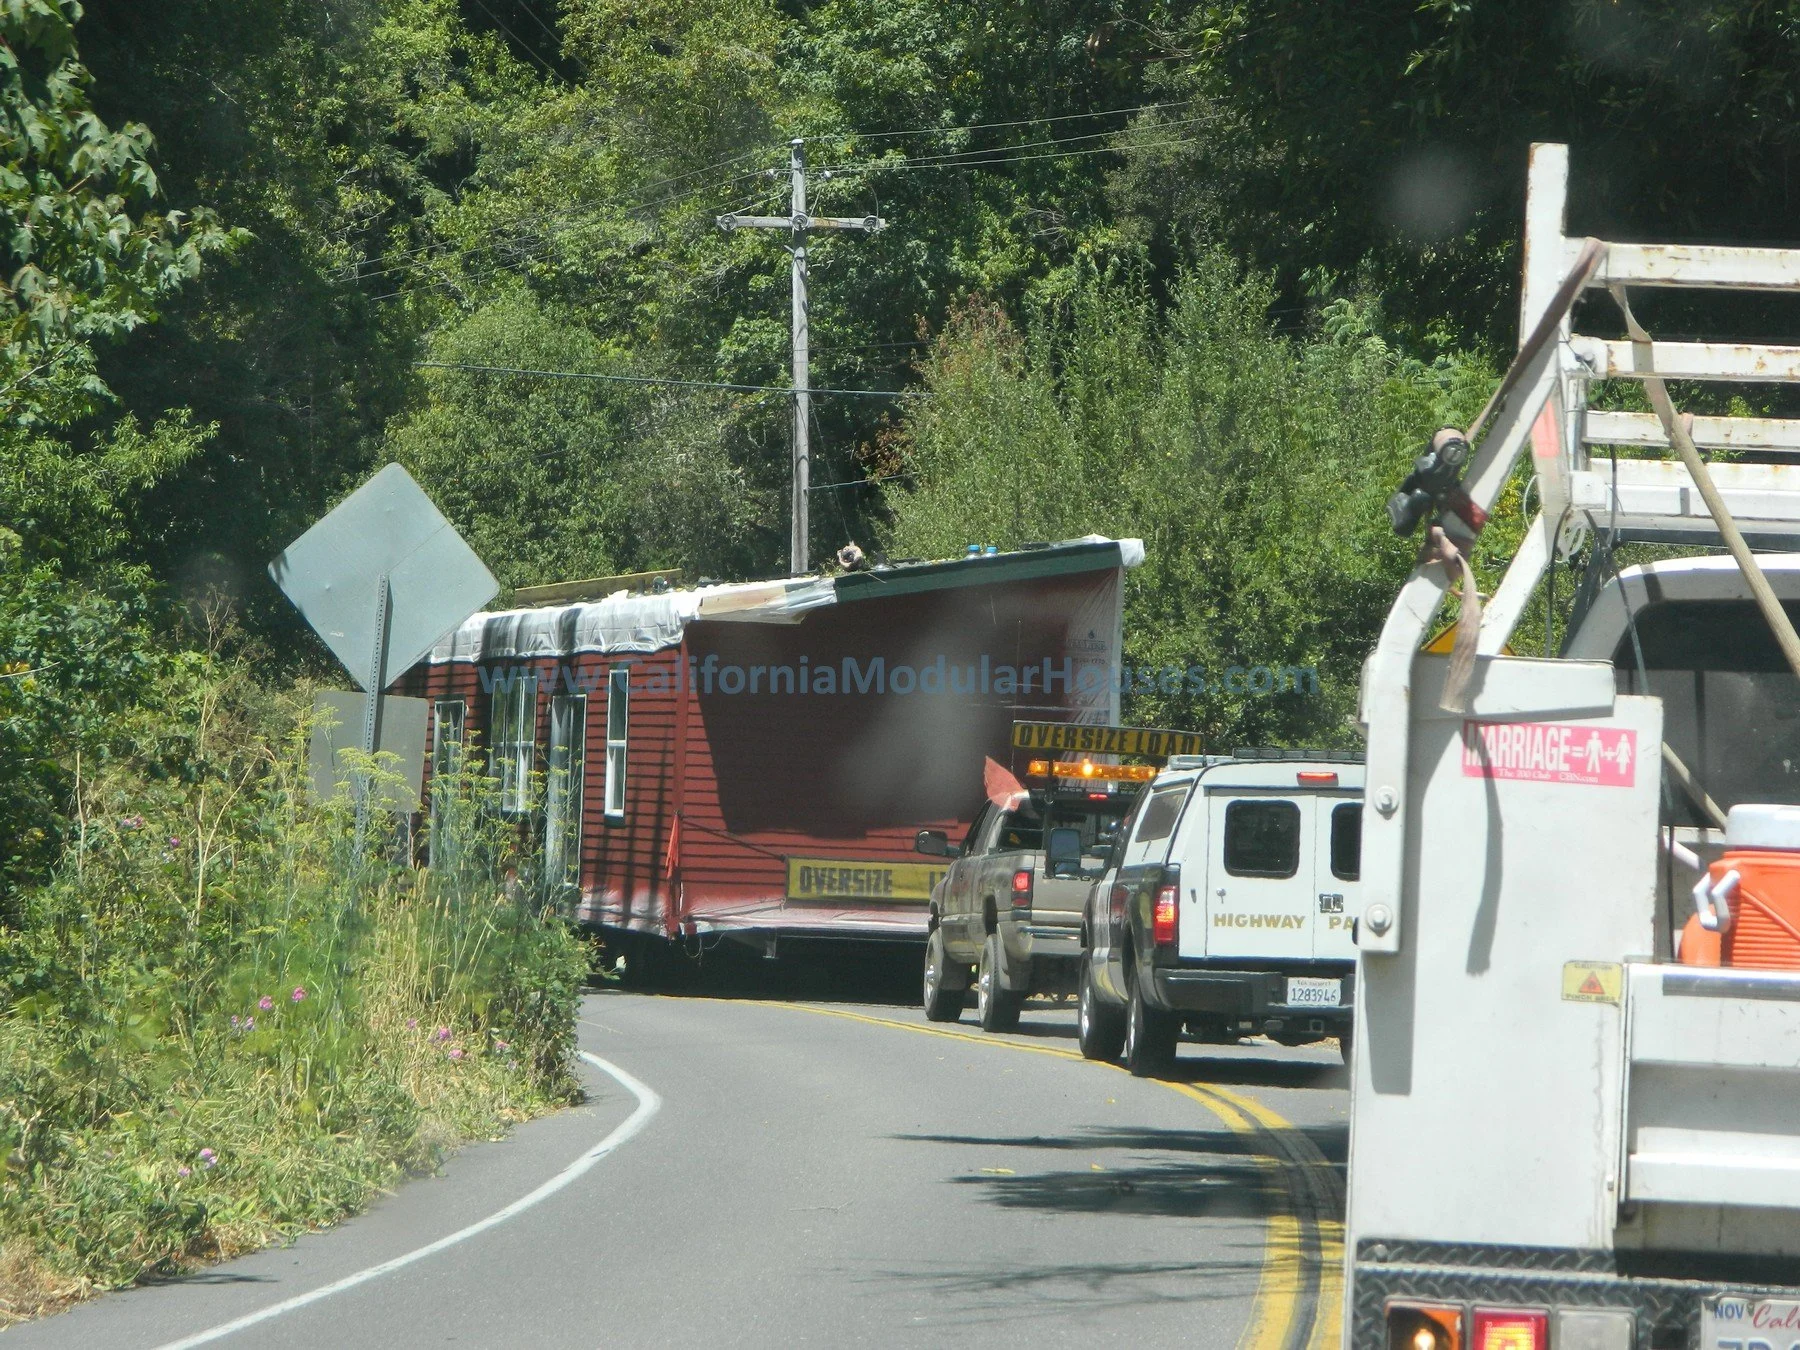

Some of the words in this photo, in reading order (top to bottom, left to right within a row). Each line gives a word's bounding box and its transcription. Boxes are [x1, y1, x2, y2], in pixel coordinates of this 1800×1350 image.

[1019, 723, 1128, 751] OVERSIZE
[1135, 732, 1195, 756] LOAD
[1465, 723, 1573, 772] MARRIAGE
[800, 866, 893, 896] OVERSIZE
[1213, 913, 1306, 929] HIGHWAY
[1714, 1303, 1745, 1319] NOV
